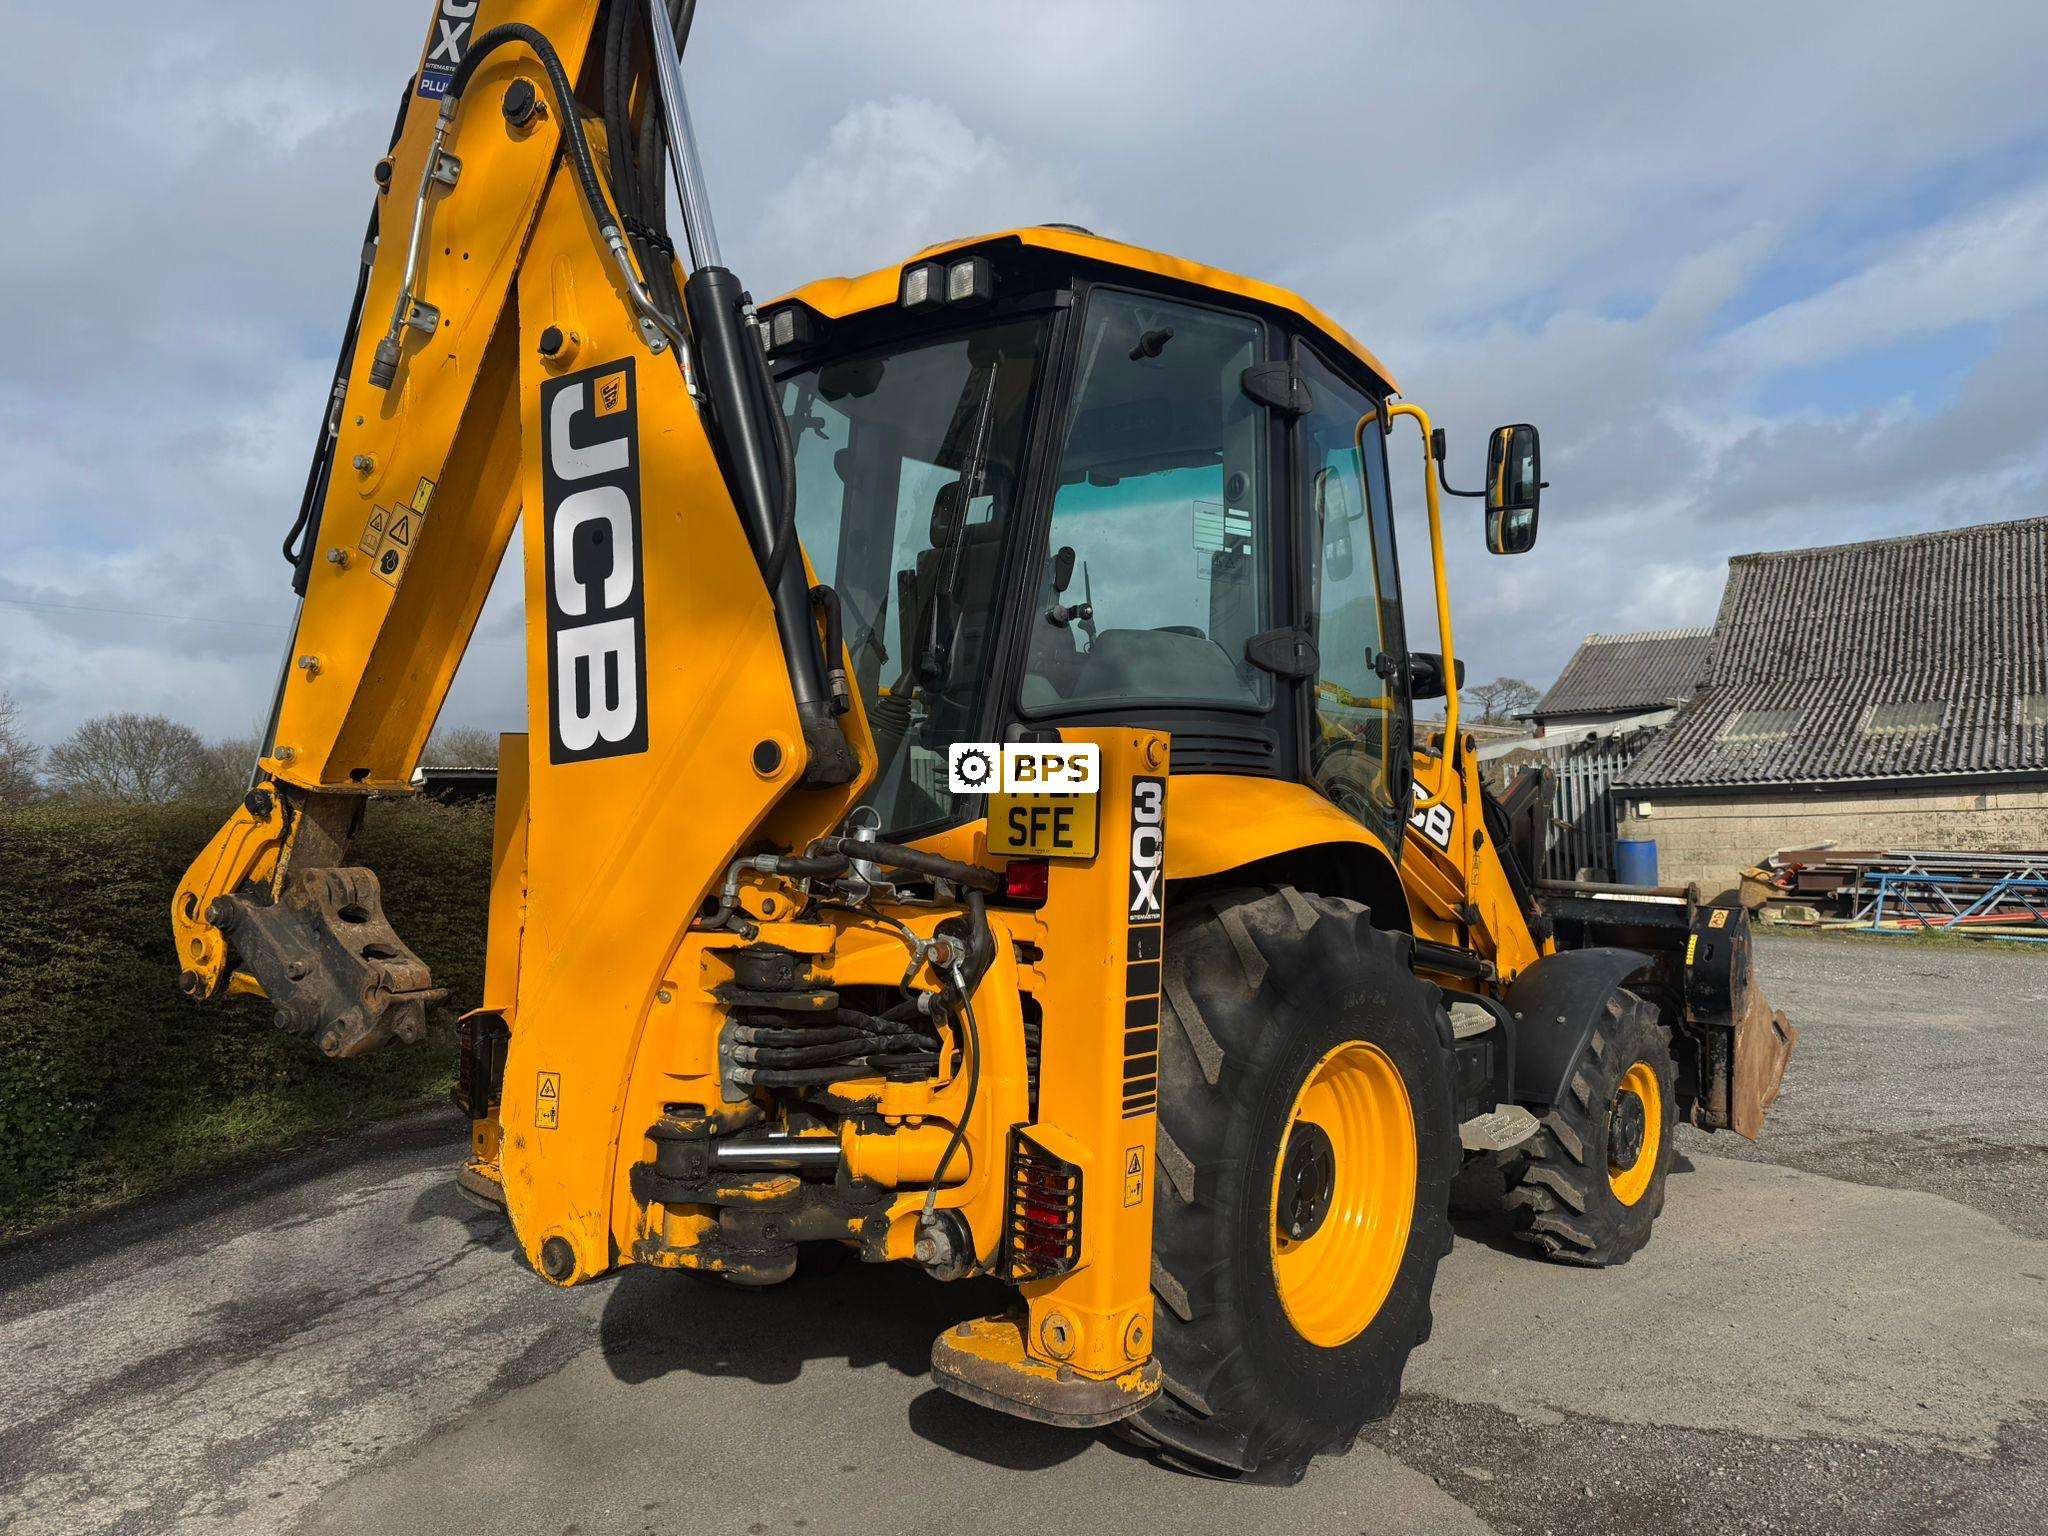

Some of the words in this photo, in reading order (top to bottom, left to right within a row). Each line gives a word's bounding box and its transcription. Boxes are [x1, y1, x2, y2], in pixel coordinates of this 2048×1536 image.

[426, 63, 456, 72] SITEMASTE
[601, 382, 618, 408] JCB
[550, 382, 637, 751] JCB
[1008, 807, 1074, 847] SFE
[1409, 782, 1451, 846] CB
[1131, 782, 1162, 911] 3CX
